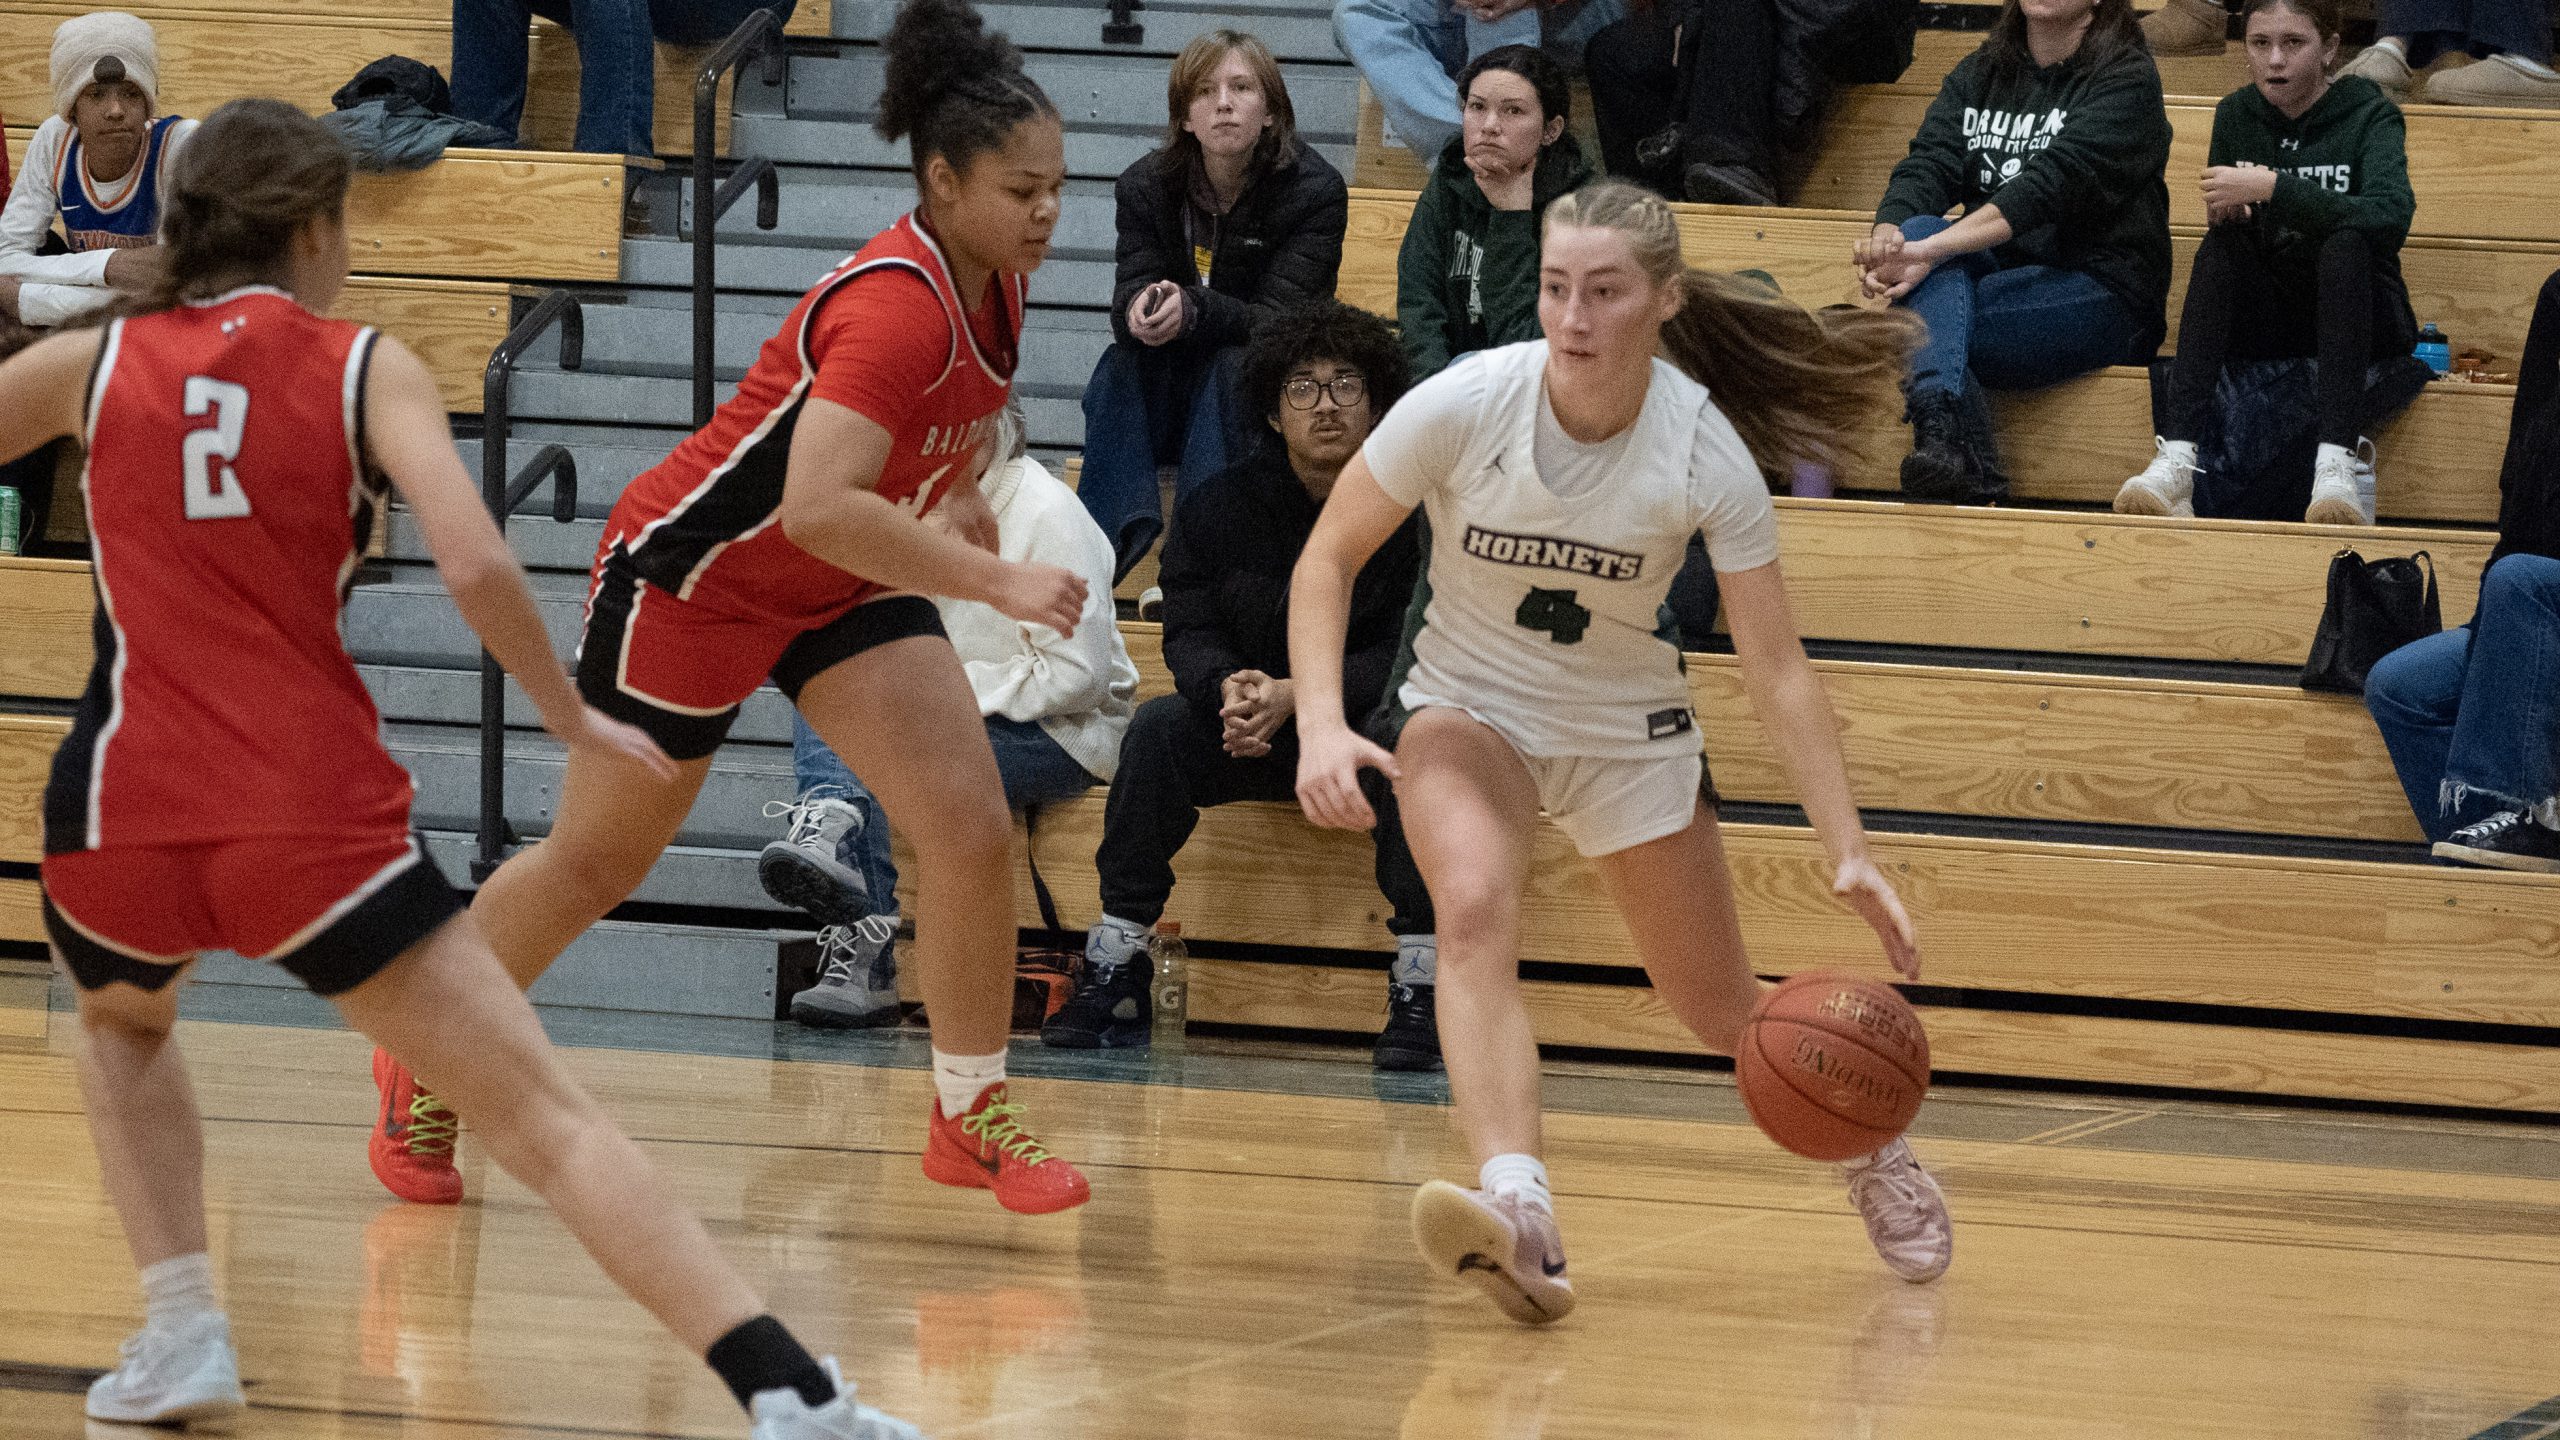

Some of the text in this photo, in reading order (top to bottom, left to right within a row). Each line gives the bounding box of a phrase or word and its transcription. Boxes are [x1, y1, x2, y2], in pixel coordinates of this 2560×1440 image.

[182, 374, 252, 521] 2
[1466, 528, 1641, 580] HORNETS
[1515, 584, 1592, 645] 4
